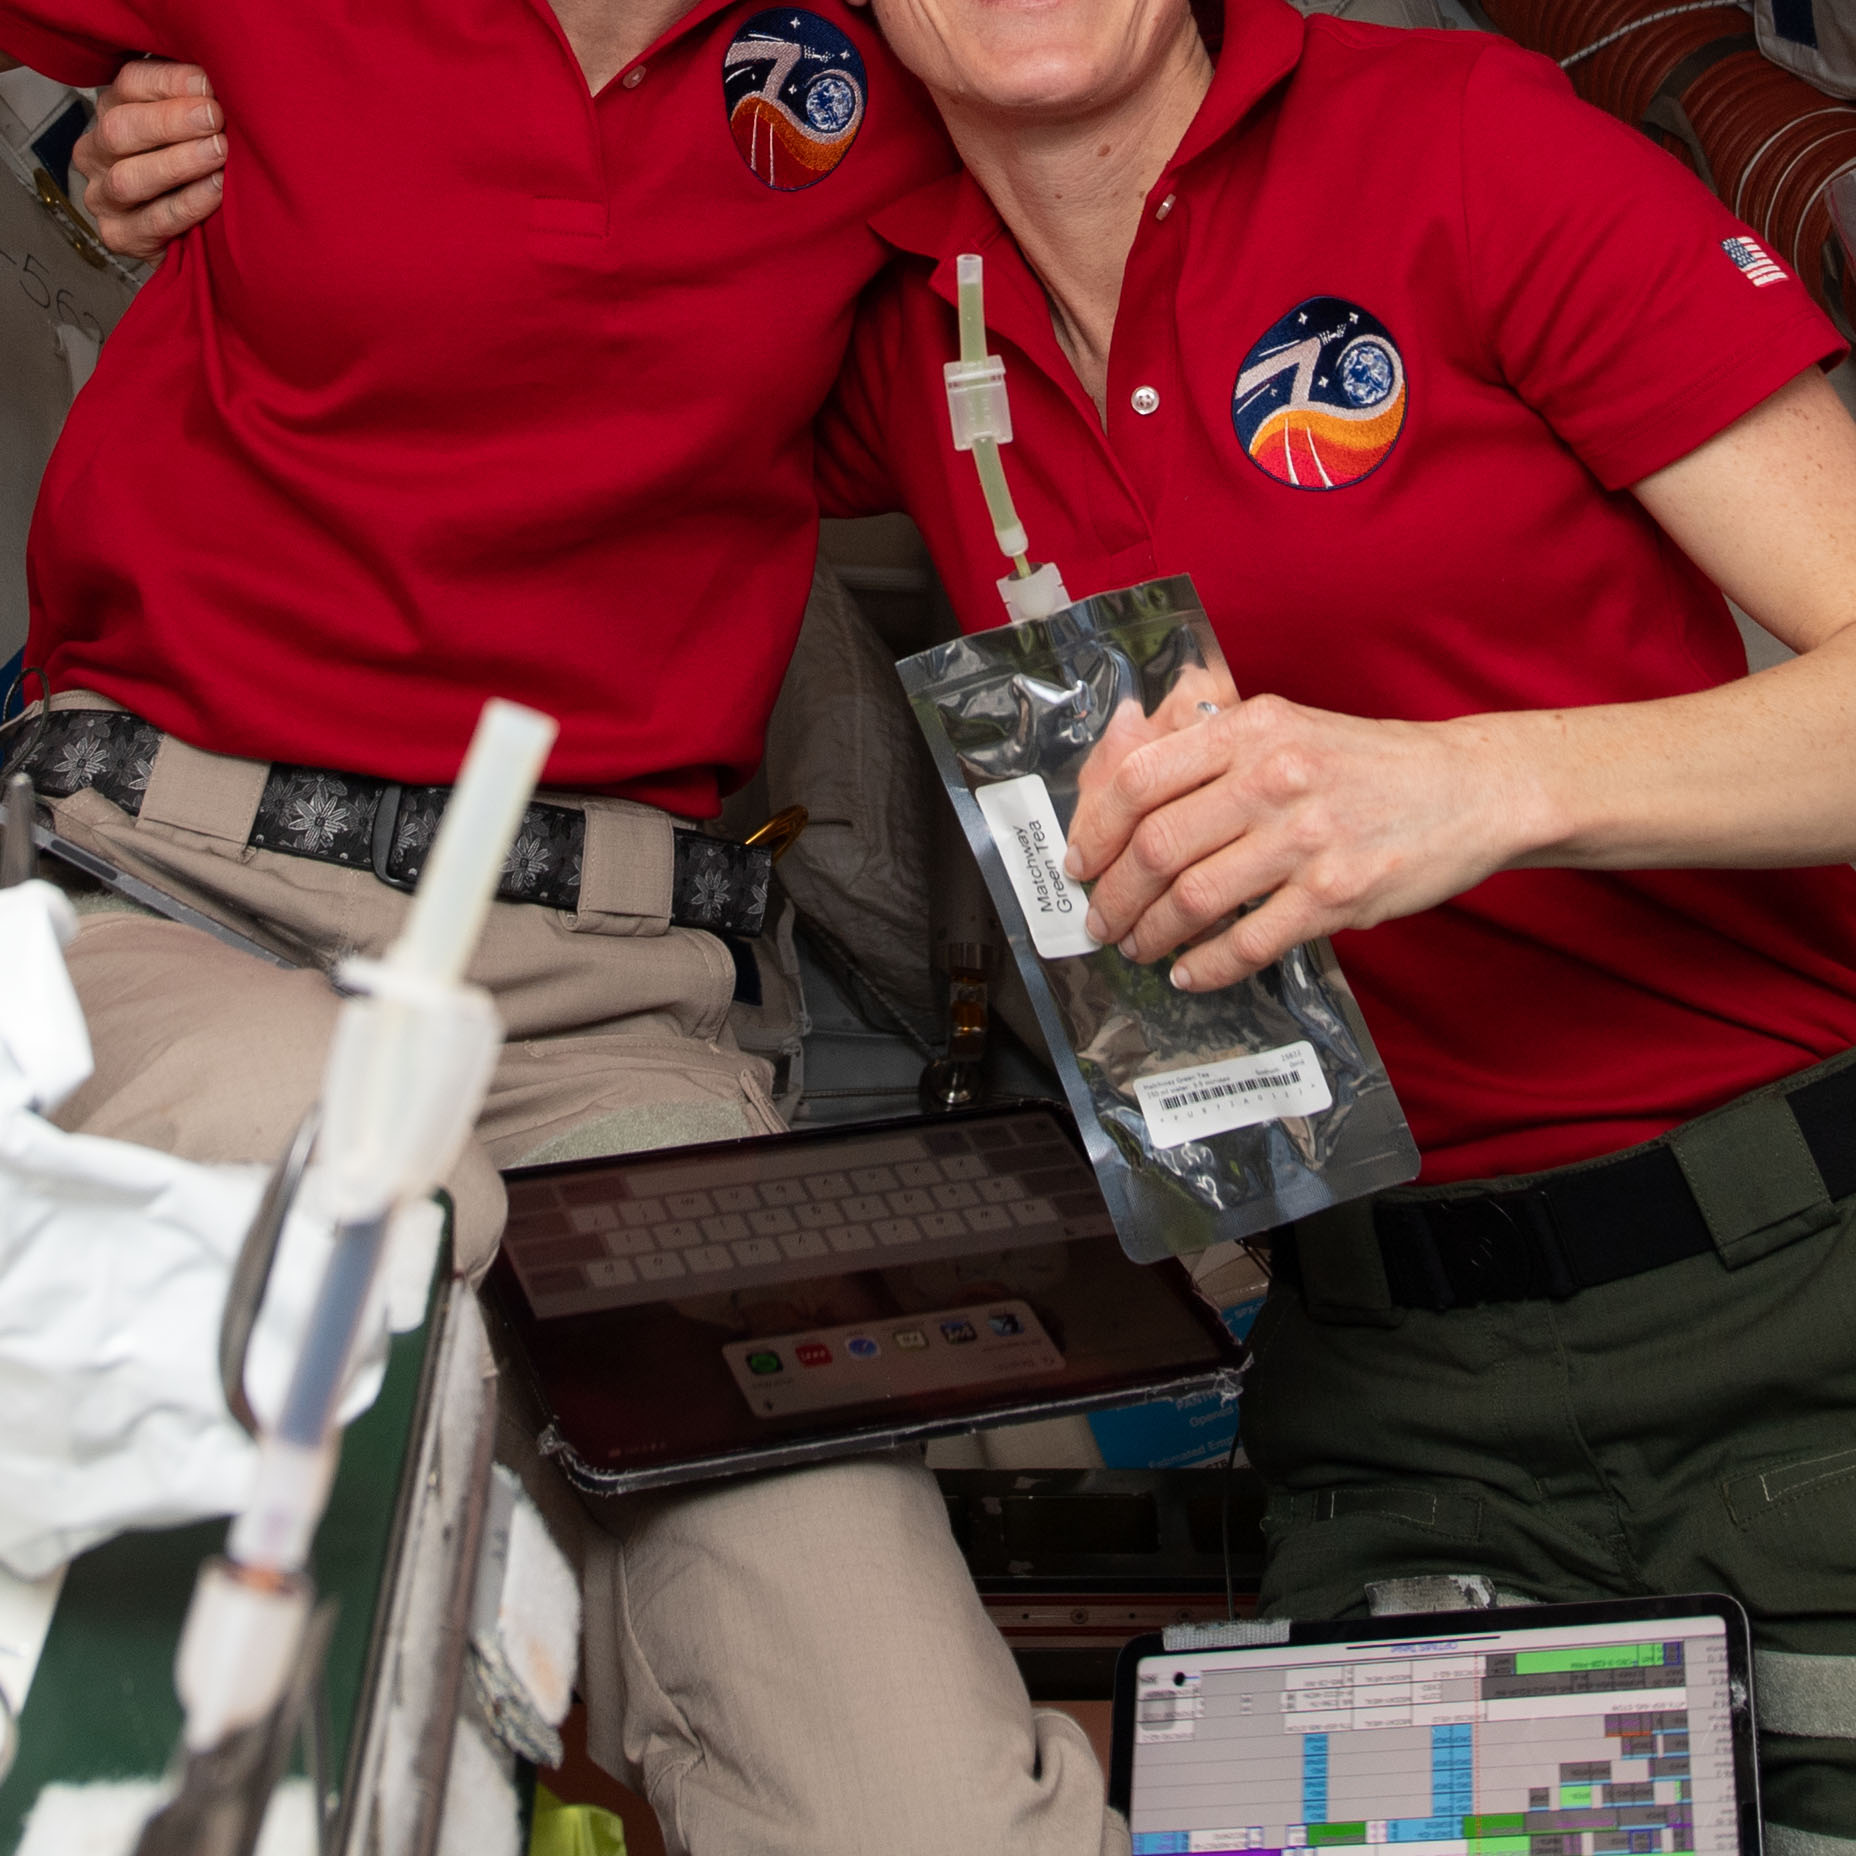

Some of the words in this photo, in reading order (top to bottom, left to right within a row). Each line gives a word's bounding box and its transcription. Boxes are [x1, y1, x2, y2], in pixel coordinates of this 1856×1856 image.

[1029, 819, 1051, 855] Tea
[1012, 824, 1054, 913] Matchway
[1044, 858, 1073, 914] Green
